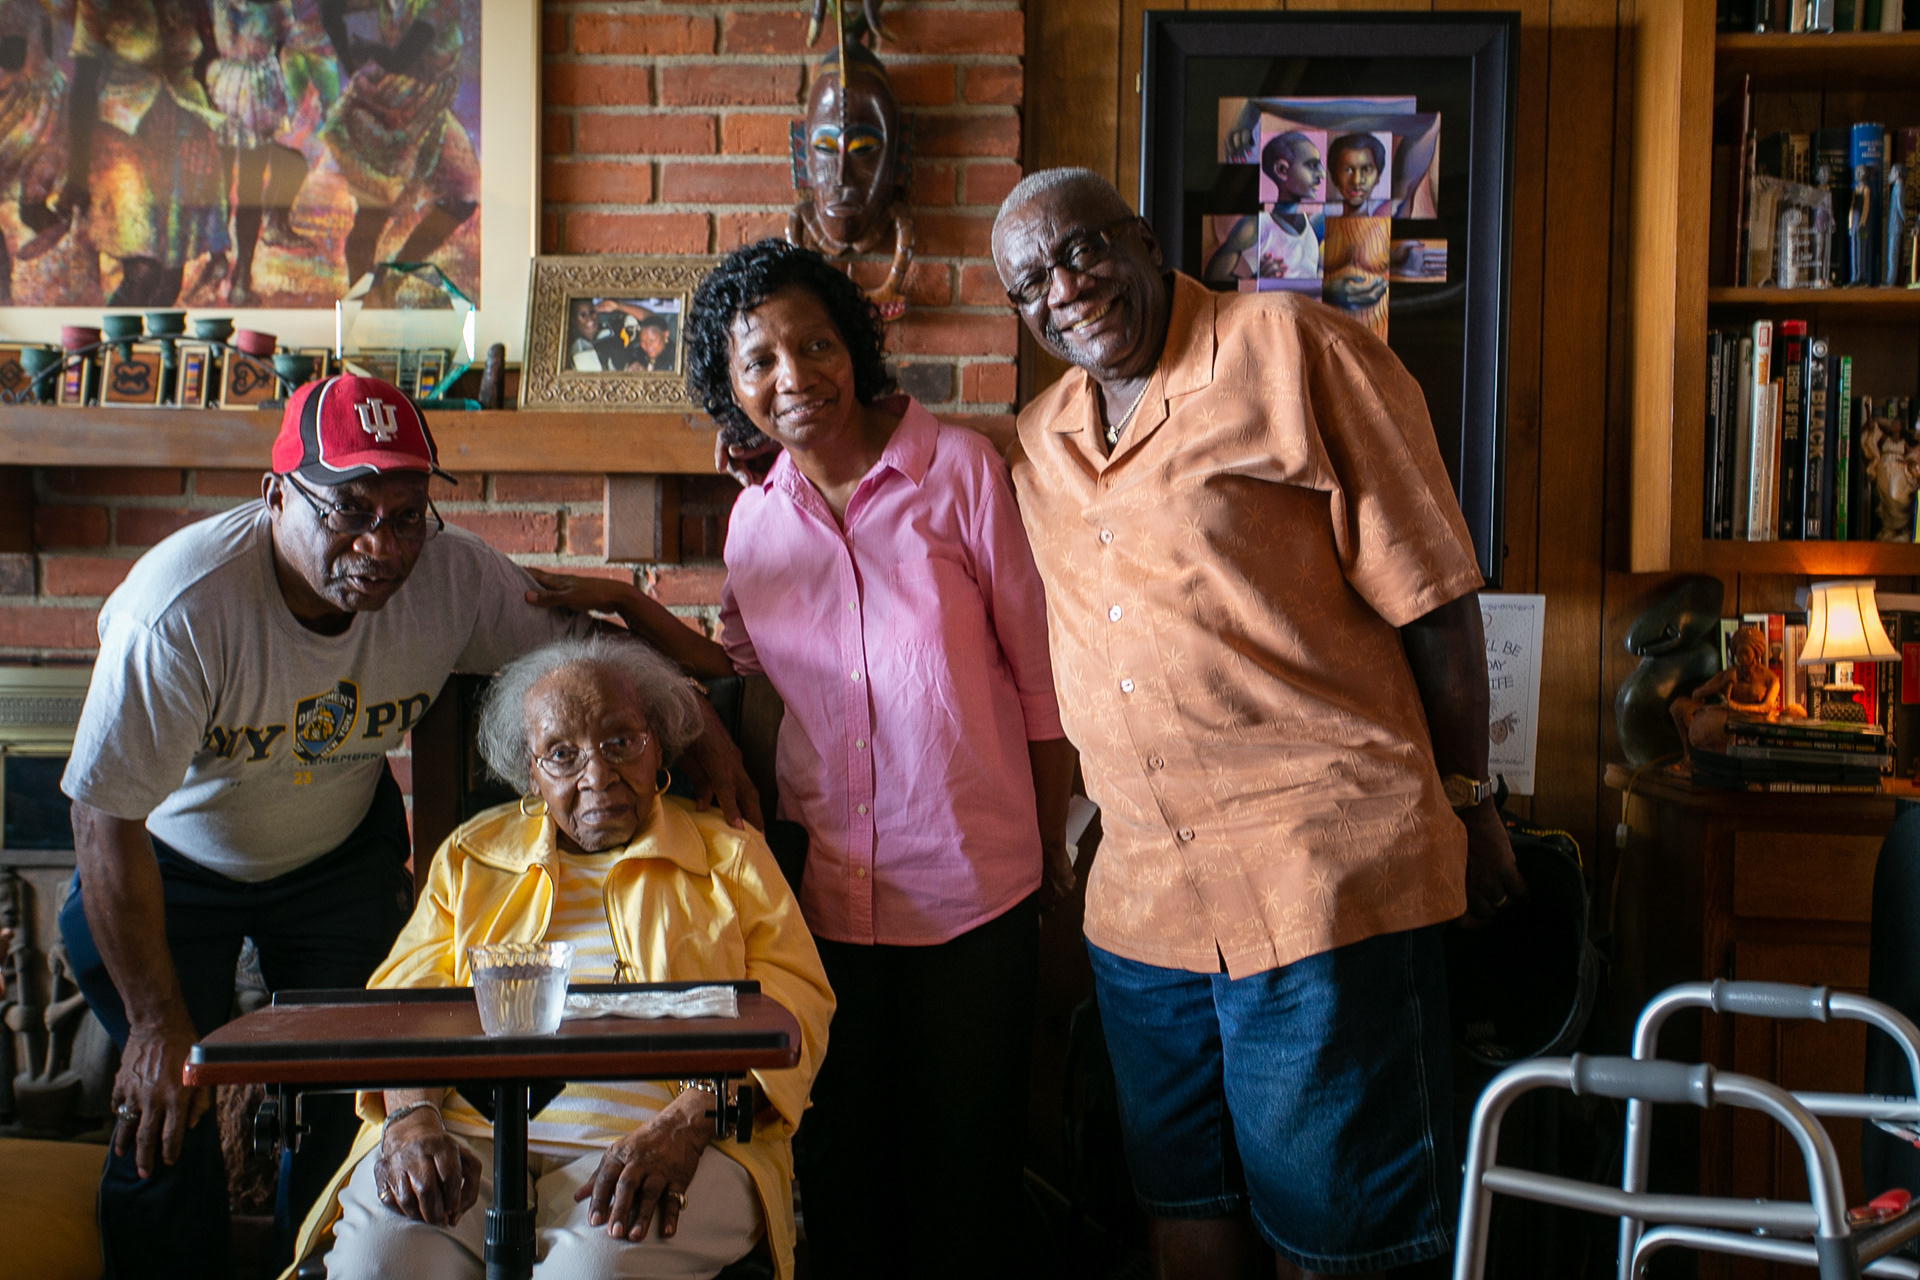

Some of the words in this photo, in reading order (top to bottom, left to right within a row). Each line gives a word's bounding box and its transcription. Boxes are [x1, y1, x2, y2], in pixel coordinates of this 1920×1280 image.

[1809, 389, 1826, 460] BLACK
[201, 724, 287, 765] NY
[361, 692, 432, 741] PD
[293, 771, 312, 786] 23
[1769, 783, 1791, 792] JAMES
[1791, 783, 1816, 793] BROWN
[1817, 784, 1831, 793] LIVE
